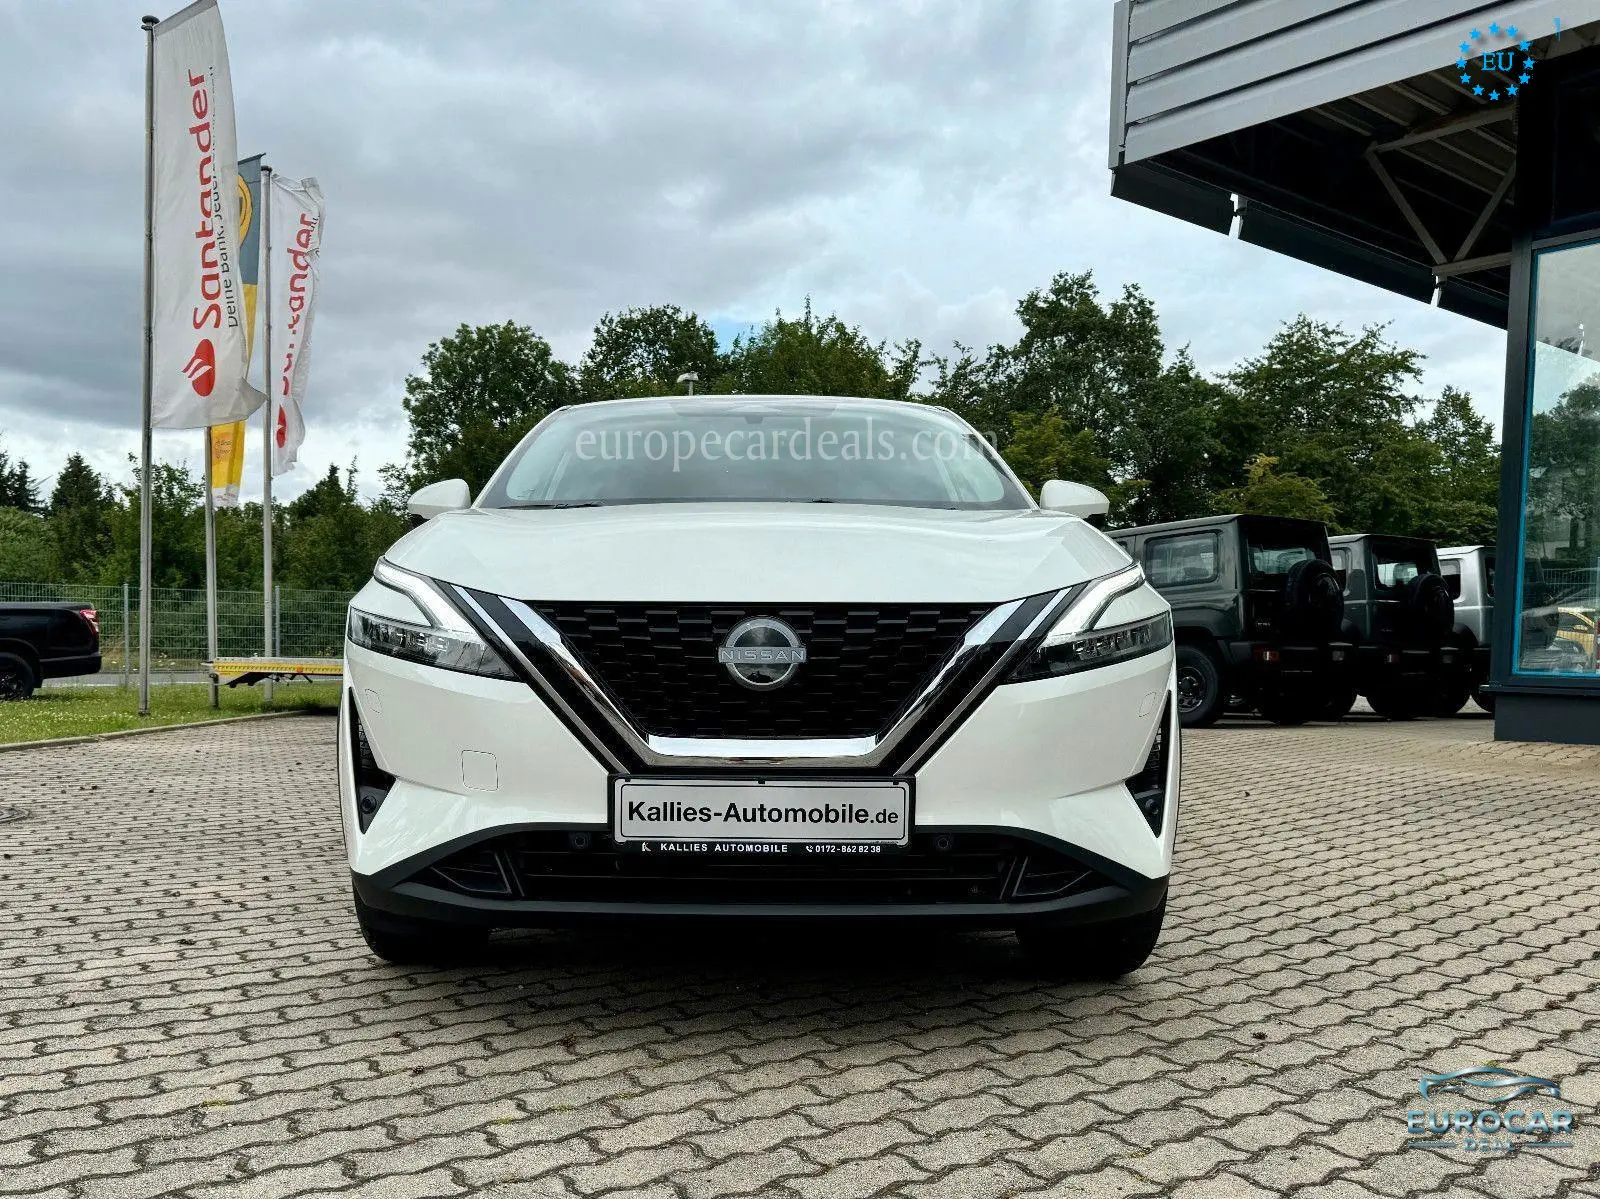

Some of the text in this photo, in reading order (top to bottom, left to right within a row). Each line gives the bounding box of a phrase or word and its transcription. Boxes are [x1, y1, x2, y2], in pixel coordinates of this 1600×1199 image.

[188, 69, 223, 330] Santander
[721, 650, 804, 661] NISSAN
[628, 801, 899, 824] Kallies-Automobile.de
[660, 843, 708, 852] KALLIES
[714, 843, 789, 853] AUTOMOBILE
